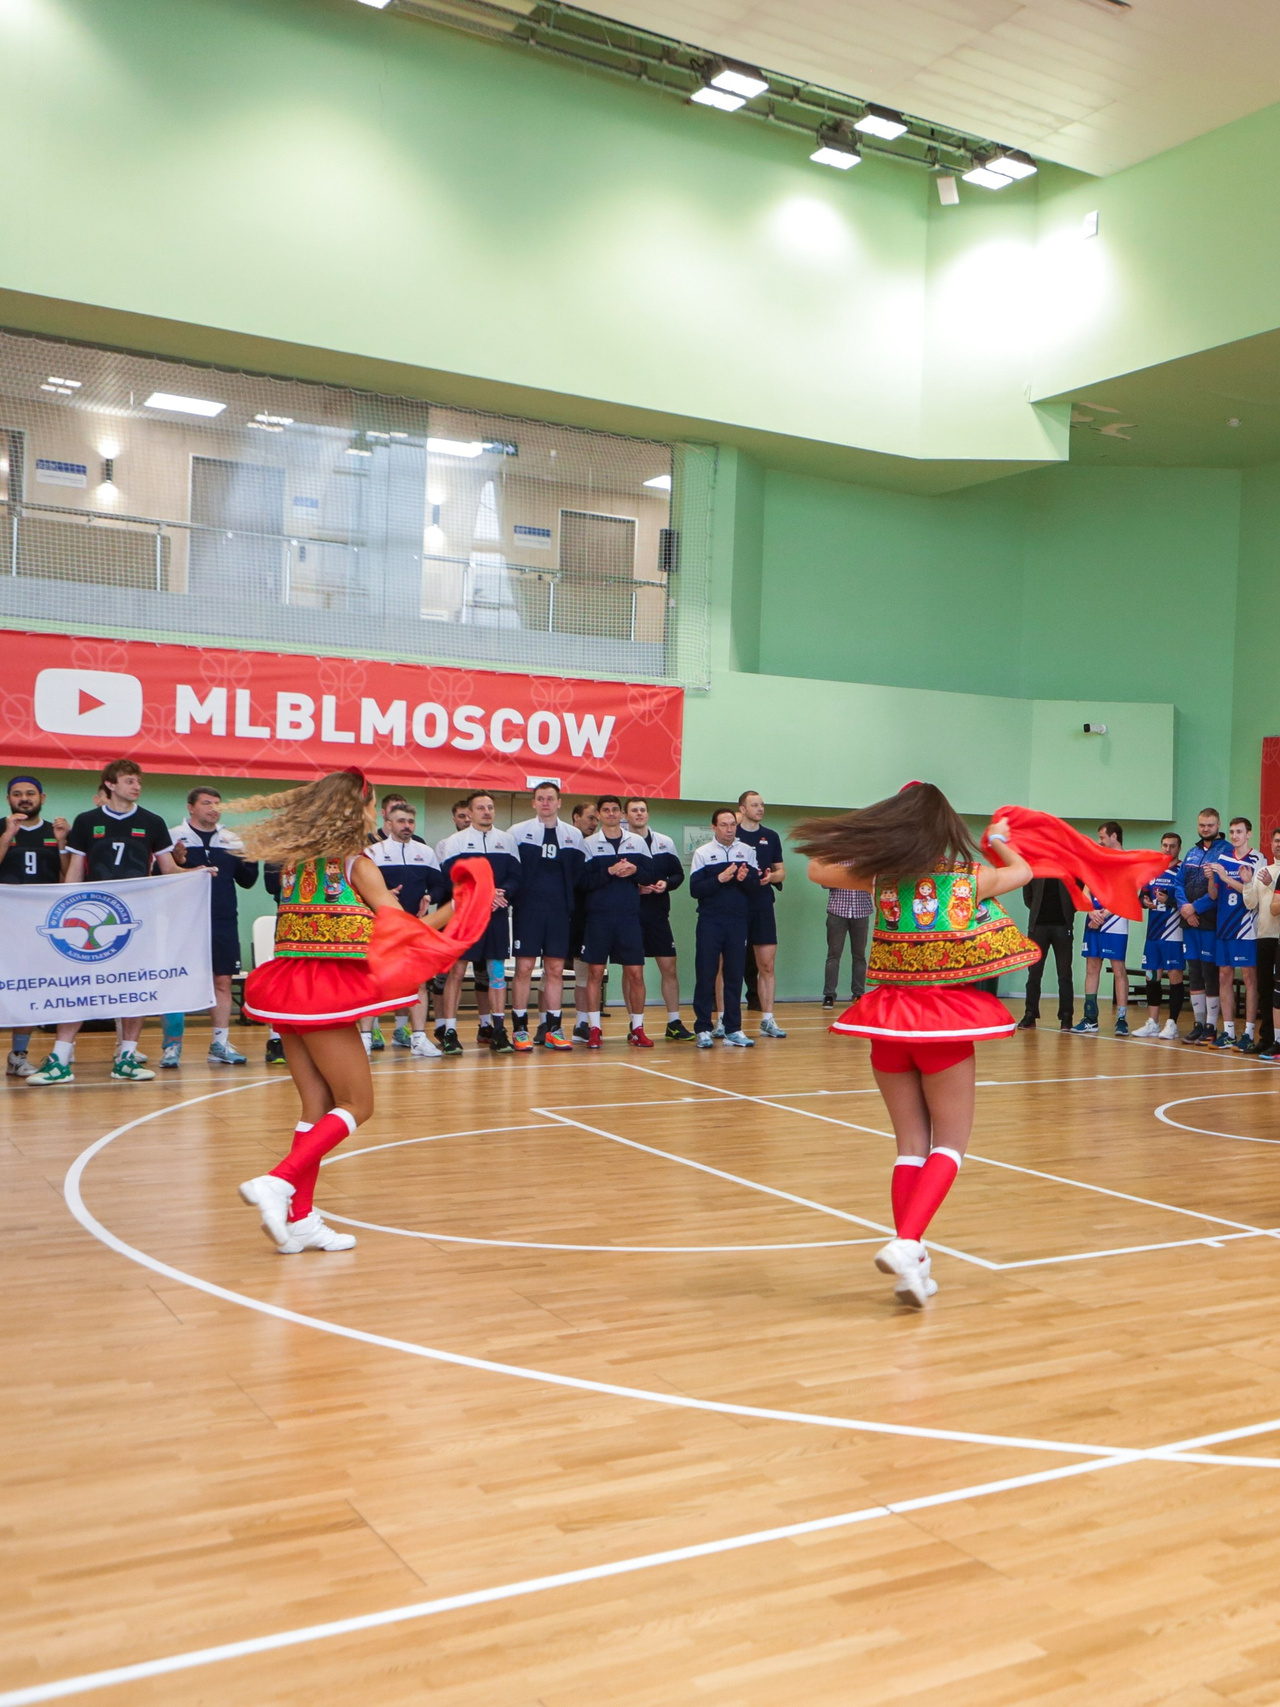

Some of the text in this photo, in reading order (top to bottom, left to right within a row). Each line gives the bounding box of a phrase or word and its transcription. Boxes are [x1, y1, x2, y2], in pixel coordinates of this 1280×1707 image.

[175, 683, 616, 758] MLBLMOSCOW
[112, 842, 125, 866] 7
[541, 843, 557, 859] 19
[25, 851, 37, 875] 9
[1227, 892, 1238, 906] 8
[96, 966, 188, 985] ВОЛЕЙБОЛА
[43, 990, 158, 1010] АЛЬМЕТЬЕВСК
